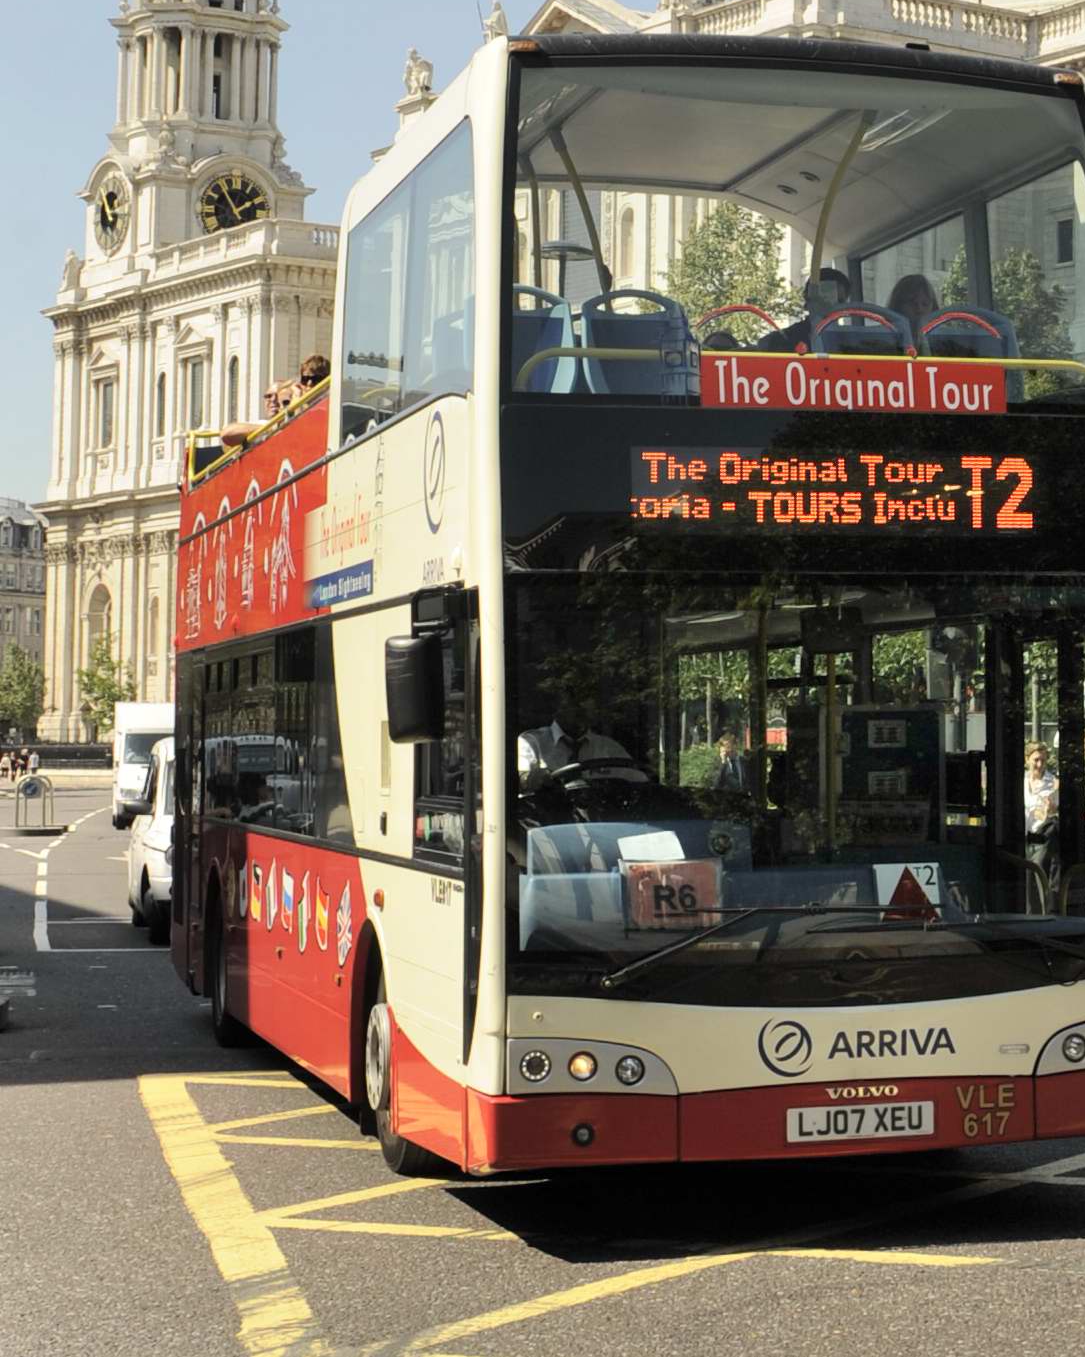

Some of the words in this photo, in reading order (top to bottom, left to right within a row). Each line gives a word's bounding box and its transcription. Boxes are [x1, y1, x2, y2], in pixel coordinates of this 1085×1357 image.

[715, 357, 769, 405] The
[785, 360, 915, 411] Original
[927, 366, 994, 412] Tour
[641, 451, 708, 484] The
[719, 452, 849, 486] Original
[859, 454, 944, 487] Tour
[747, 491, 862, 524] TOURS
[873, 492, 956, 524] Inclu
[960, 455, 1034, 529] T2
[913, 864, 937, 886] T2
[653, 884, 697, 911] R6
[828, 1027, 956, 1060] ARRIVA
[825, 1084, 899, 1100] VOLVO
[956, 1083, 1016, 1110] VLE
[798, 1108, 866, 1137] LJ07
[873, 1104, 923, 1133] XEU
[963, 1111, 1012, 1138] 617
